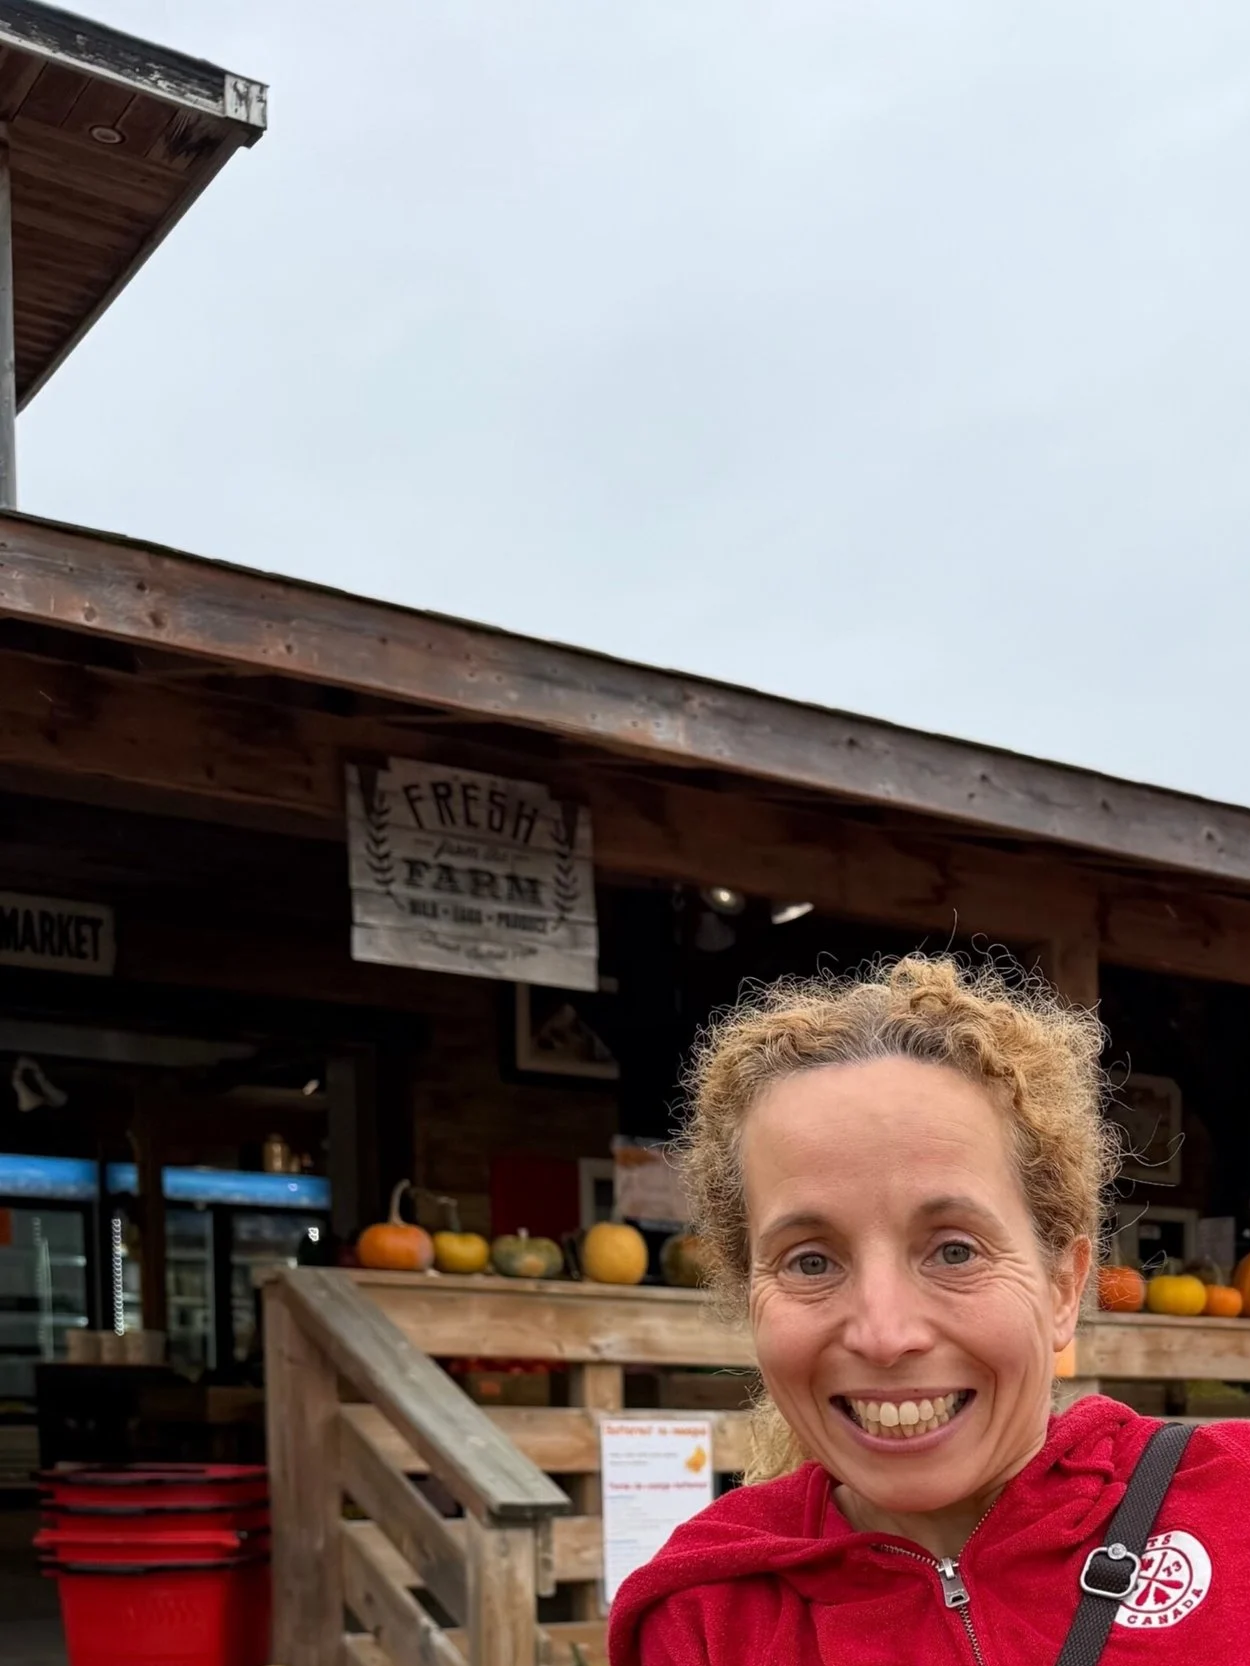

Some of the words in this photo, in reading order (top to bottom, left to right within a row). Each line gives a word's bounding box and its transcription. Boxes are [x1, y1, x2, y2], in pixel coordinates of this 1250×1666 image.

[402, 779, 541, 844] FRESH
[402, 858, 543, 907] FARM
[0, 905, 104, 962] MARKET
[1162, 1560, 1182, 1577] 73
[1127, 1587, 1204, 1626] CANADA
